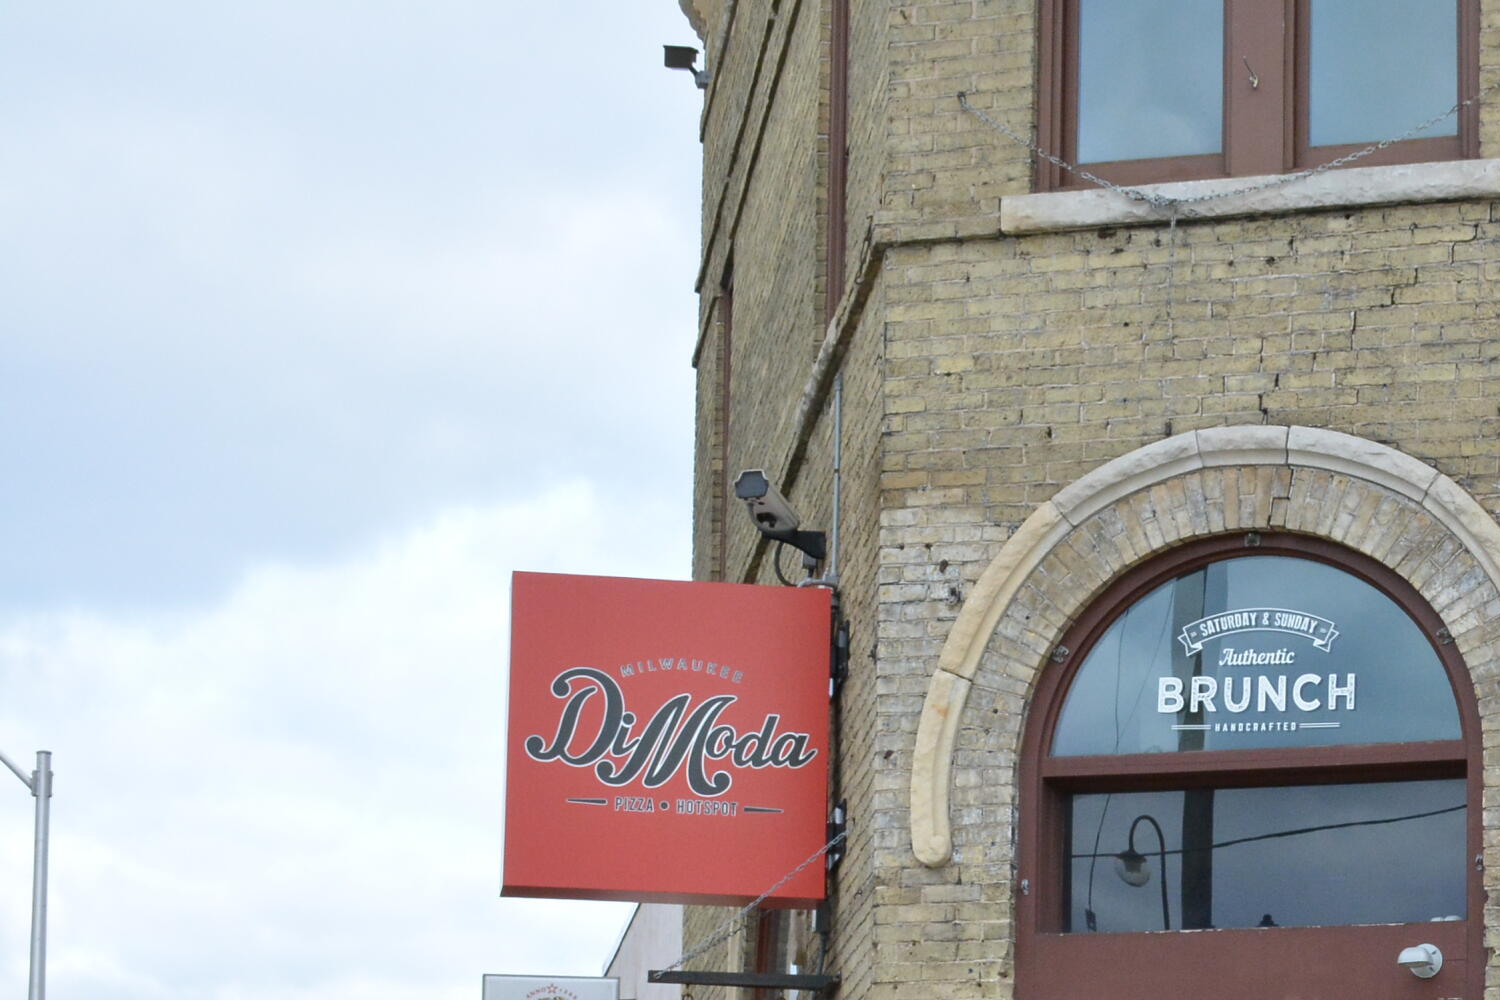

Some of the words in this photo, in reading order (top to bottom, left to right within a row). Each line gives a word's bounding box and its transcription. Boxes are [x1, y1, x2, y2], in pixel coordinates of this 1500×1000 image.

[1200, 611, 1257, 637] SATURDAY
[1262, 612, 1270, 625] &
[1274, 612, 1319, 634] SUNDAY
[1219, 647, 1295, 666] Authentic
[620, 658, 744, 683] MILWAUKEE
[1157, 673, 1356, 713] BRUNCH
[1214, 721, 1297, 732] HANDCRAFTED
[615, 796, 655, 812] PIZZA
[676, 798, 738, 816] HOTSPOT
